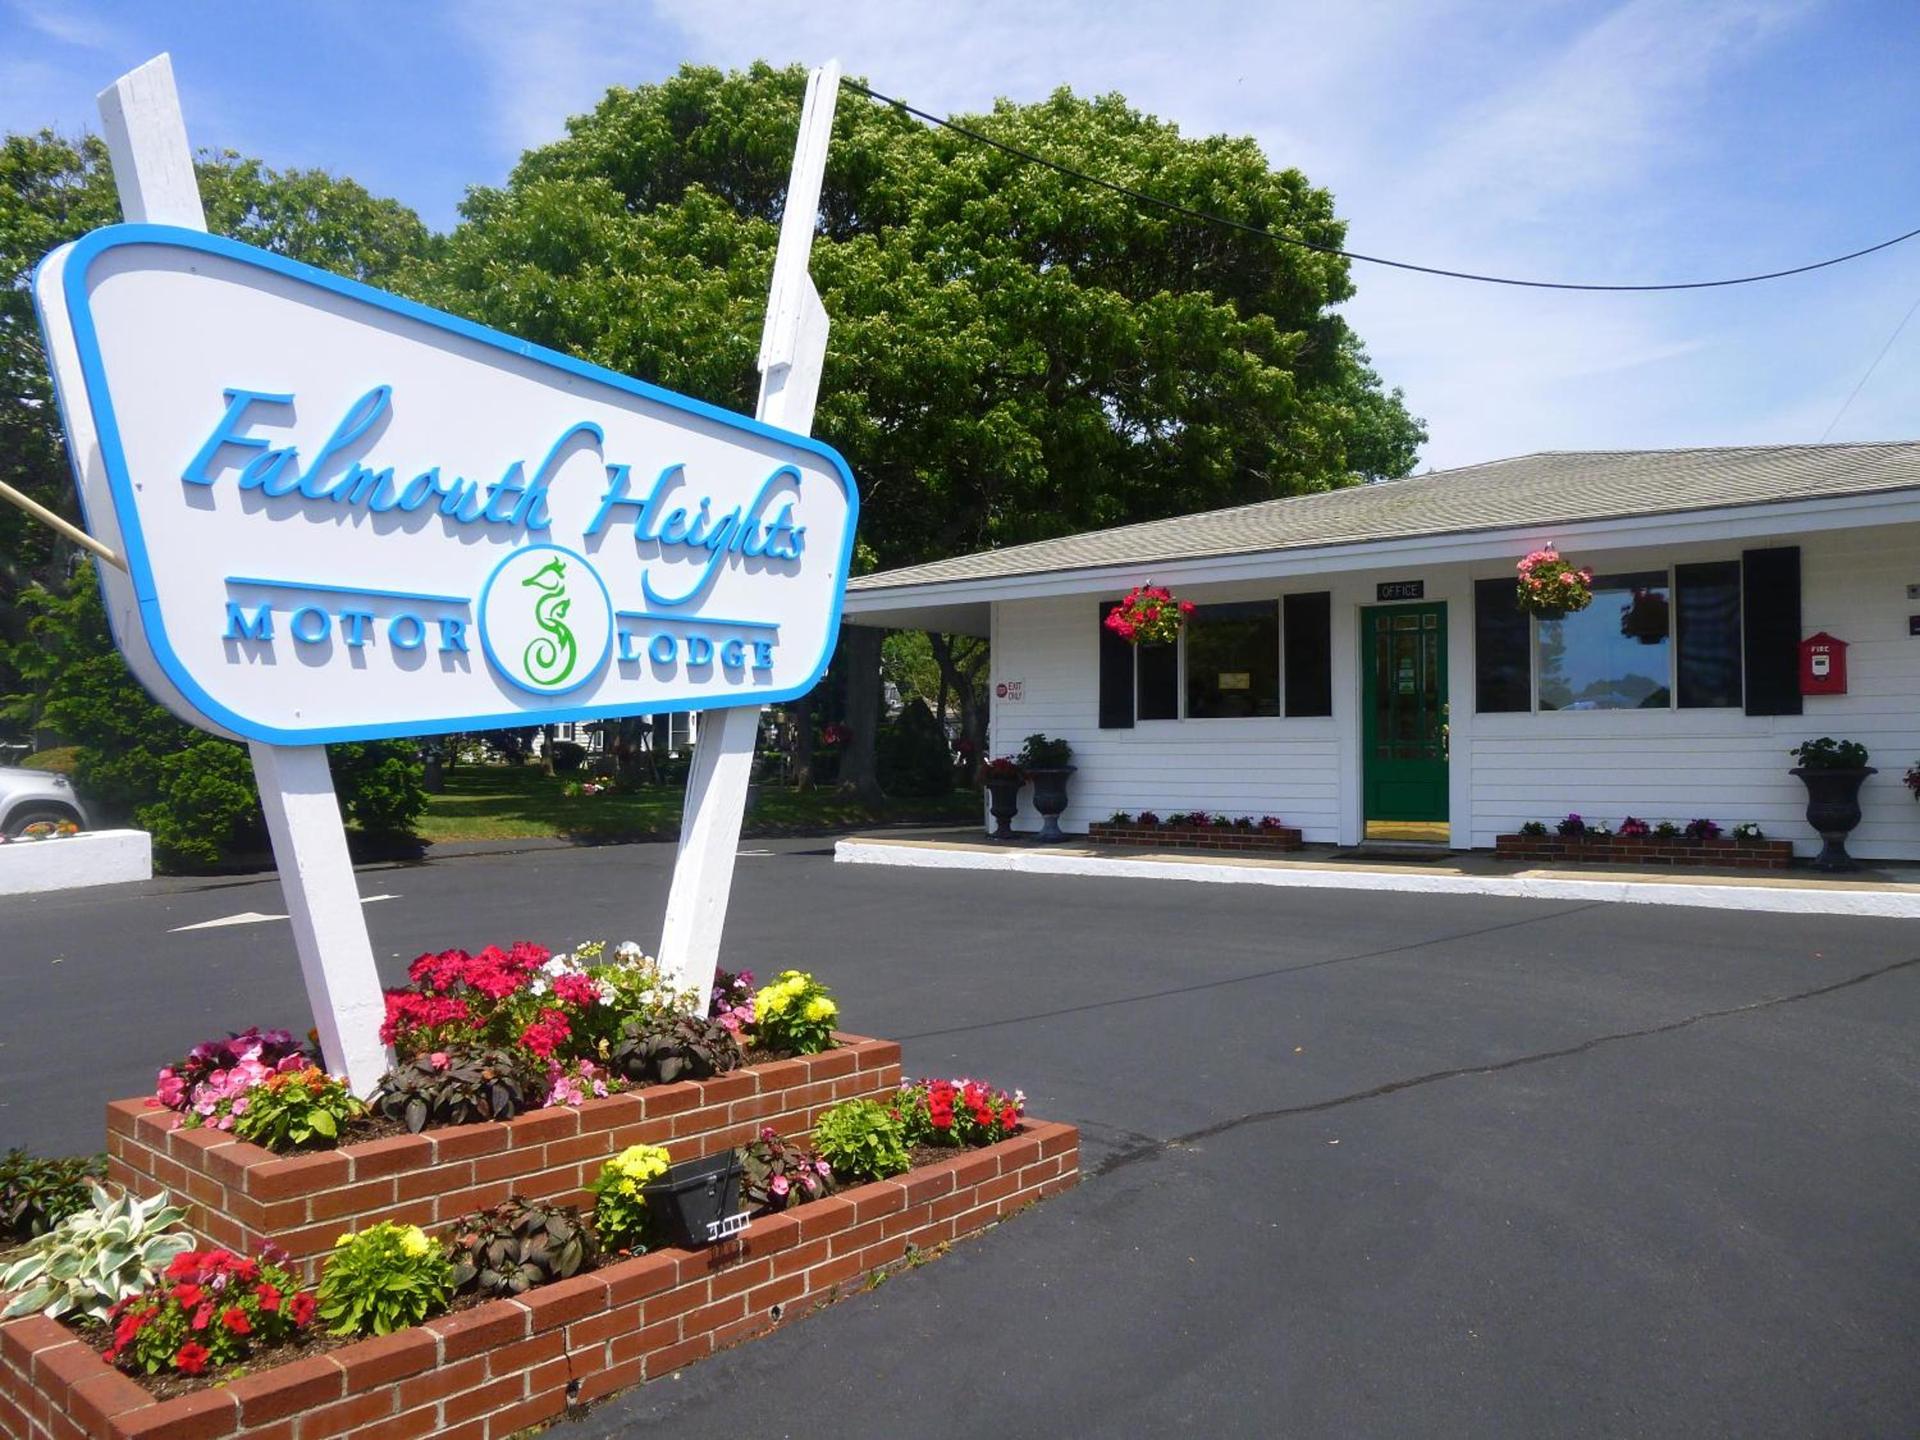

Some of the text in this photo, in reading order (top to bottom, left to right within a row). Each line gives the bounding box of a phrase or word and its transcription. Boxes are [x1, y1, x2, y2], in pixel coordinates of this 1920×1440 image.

[181, 385, 806, 607] Falmouth Heights
[1382, 584, 1418, 598] OFFICE
[223, 600, 775, 670] MOTOR LODGE
